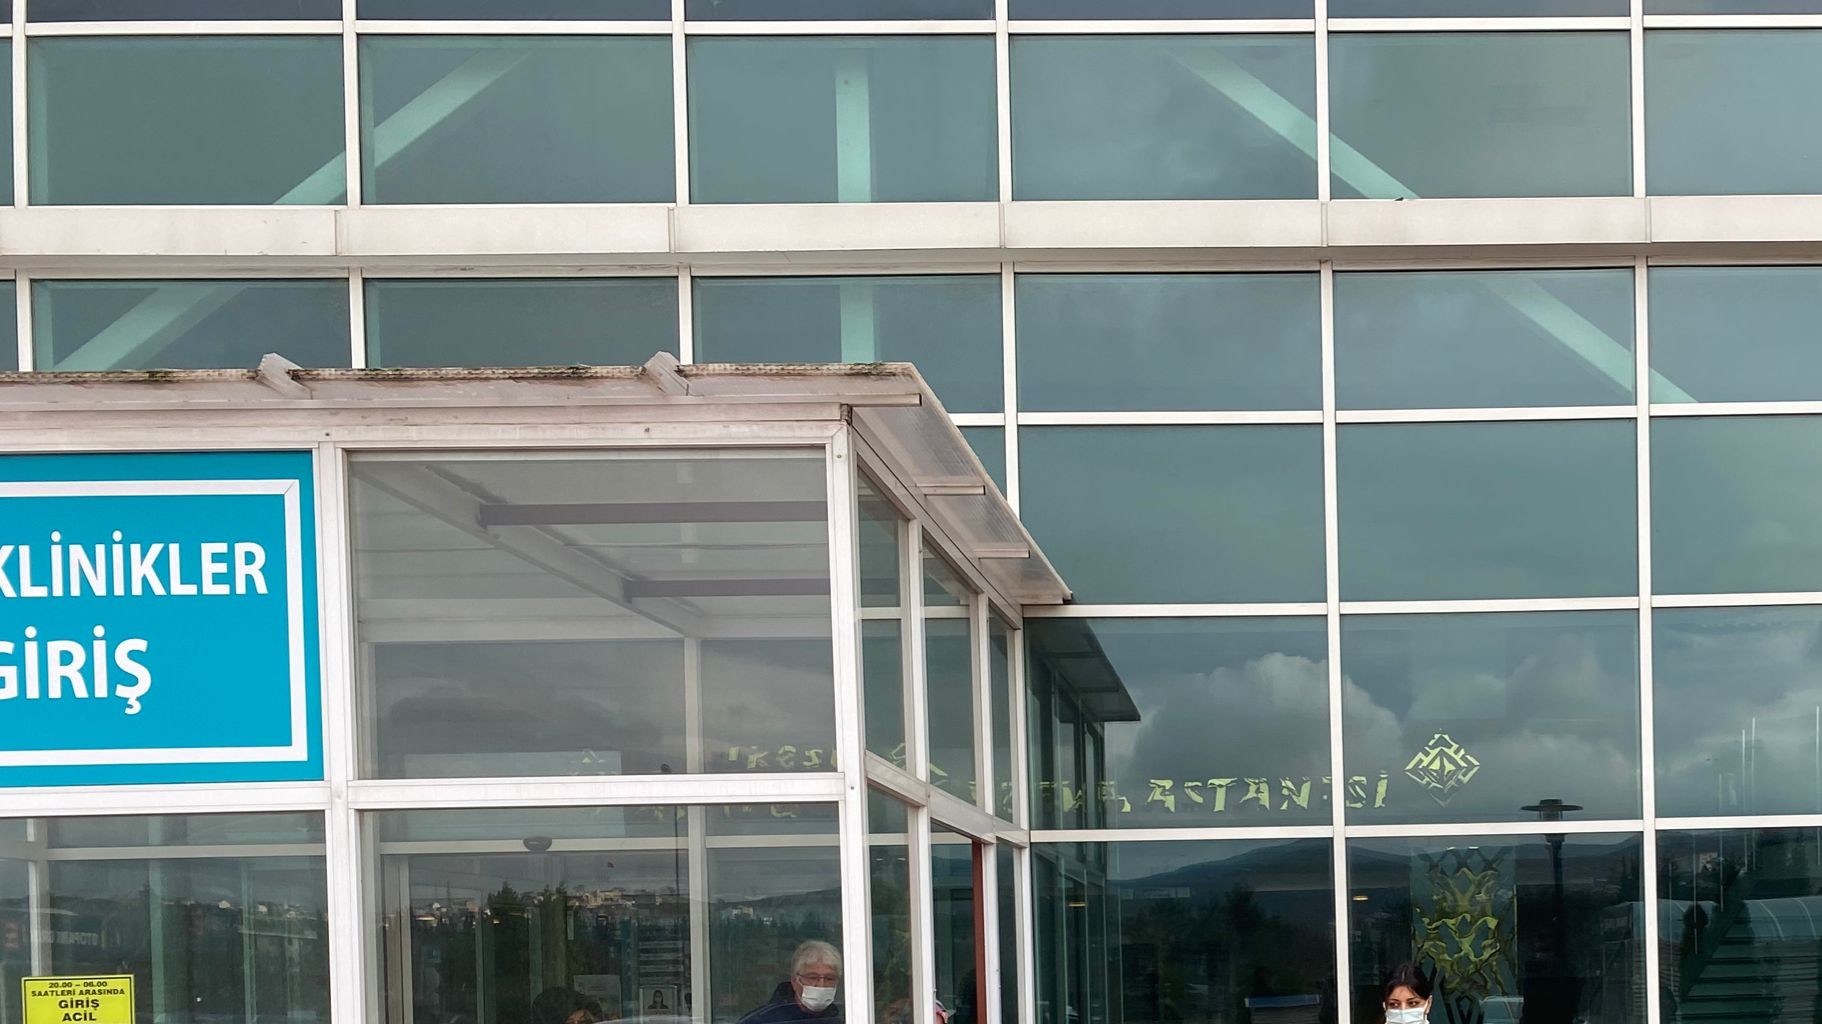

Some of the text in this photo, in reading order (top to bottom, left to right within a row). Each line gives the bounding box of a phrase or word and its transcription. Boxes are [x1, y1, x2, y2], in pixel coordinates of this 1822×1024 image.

[48, 981, 73, 989] 20.00
[31, 988, 125, 997] SAATLERİ ARASINDA
[58, 997, 100, 1011] GİRİŞ
[62, 1010, 97, 1022] ACİL
